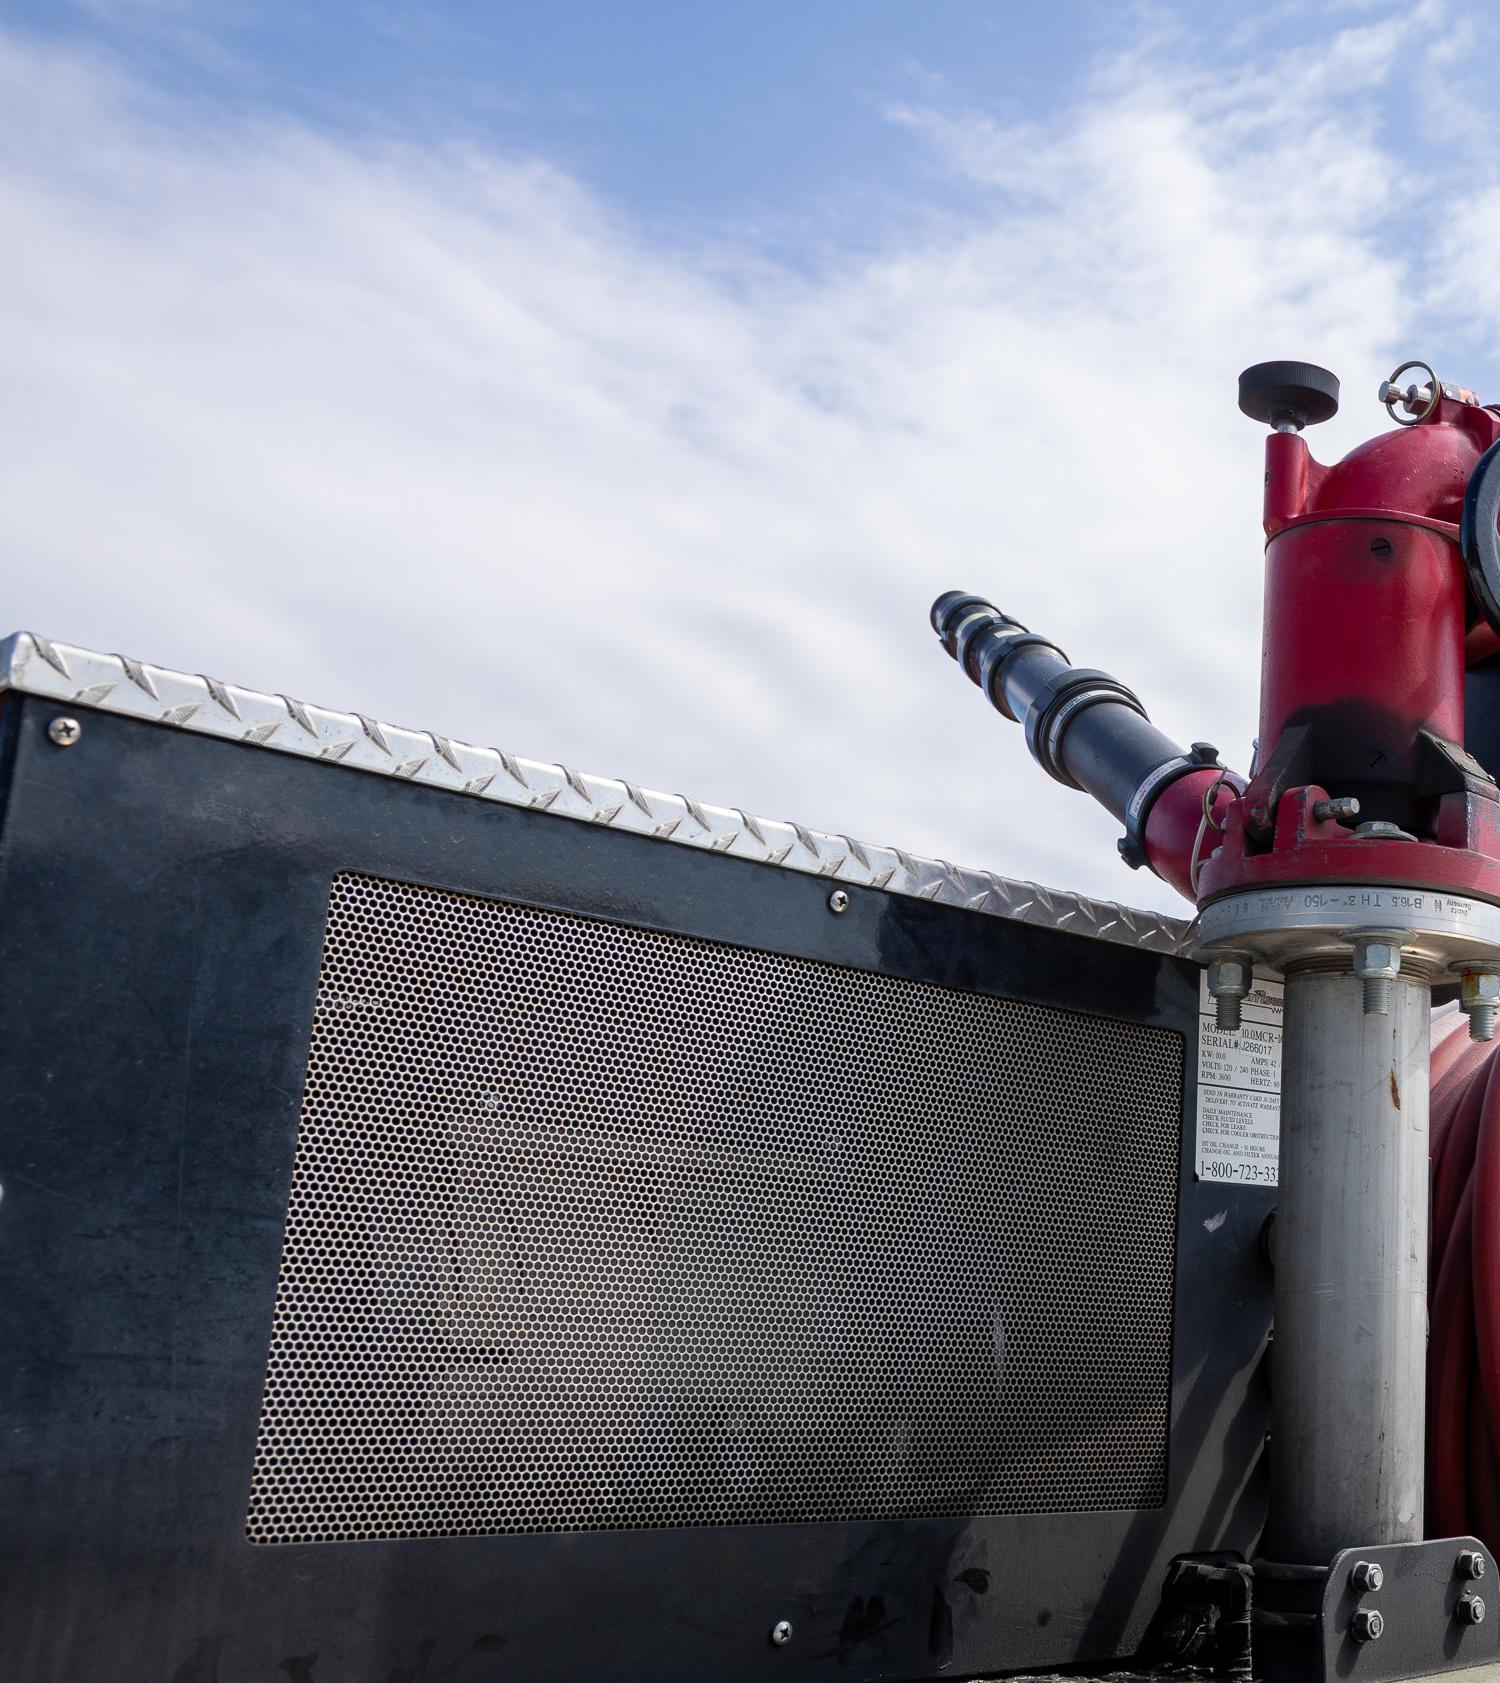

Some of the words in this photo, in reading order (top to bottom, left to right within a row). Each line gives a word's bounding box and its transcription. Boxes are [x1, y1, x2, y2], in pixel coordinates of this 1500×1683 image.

[1392, 896, 1422, 909] B16.5
[1242, 1028, 1283, 1044] 10.0MCR-1
[1201, 1161, 1279, 1182] 1-800-723-33
